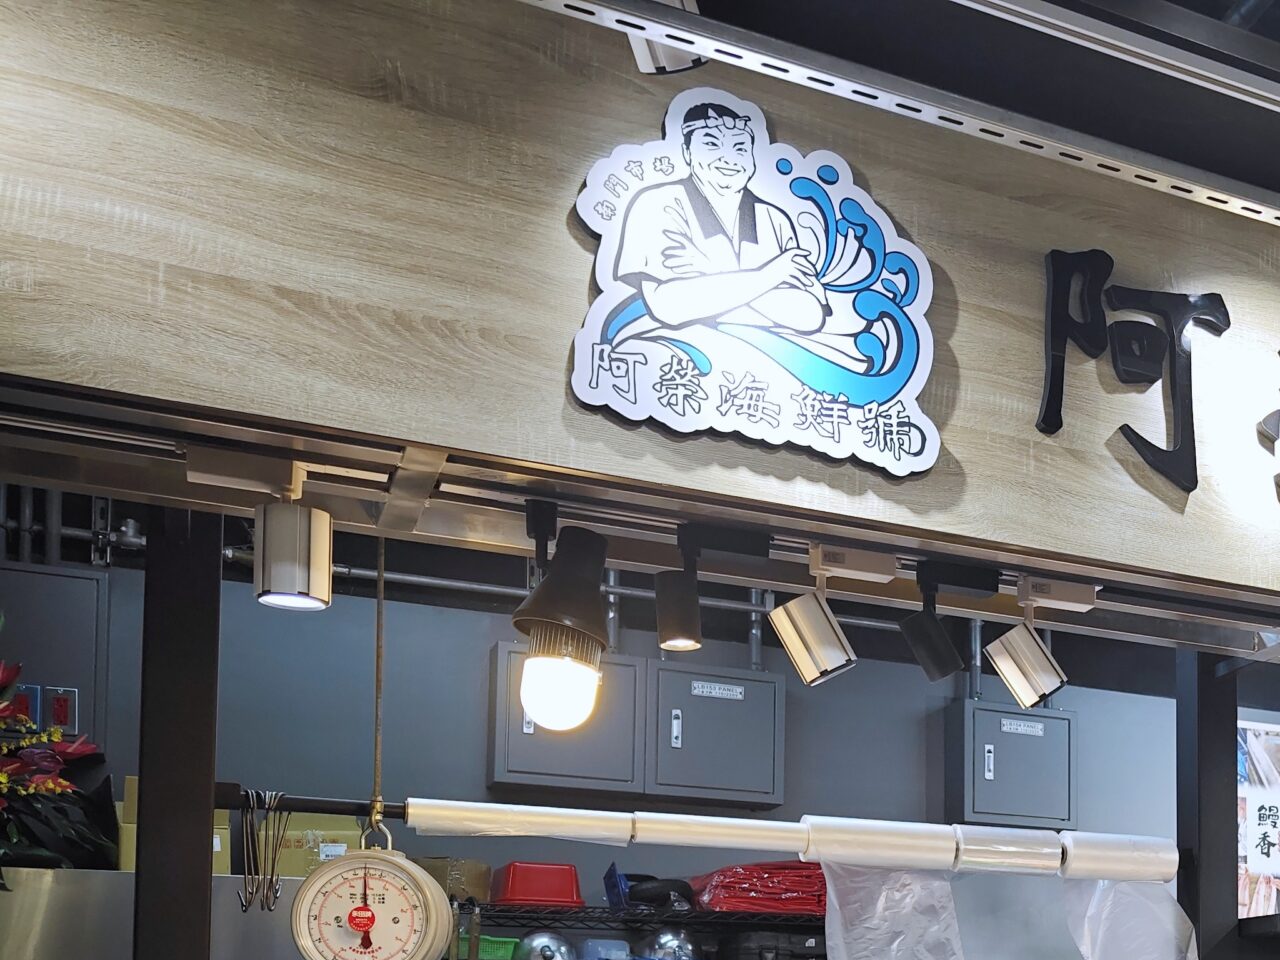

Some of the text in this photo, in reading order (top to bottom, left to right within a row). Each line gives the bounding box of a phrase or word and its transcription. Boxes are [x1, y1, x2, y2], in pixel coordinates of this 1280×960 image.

[595, 156, 675, 221] 南門市場
[590, 343, 926, 461] 阿榮海鮮號
